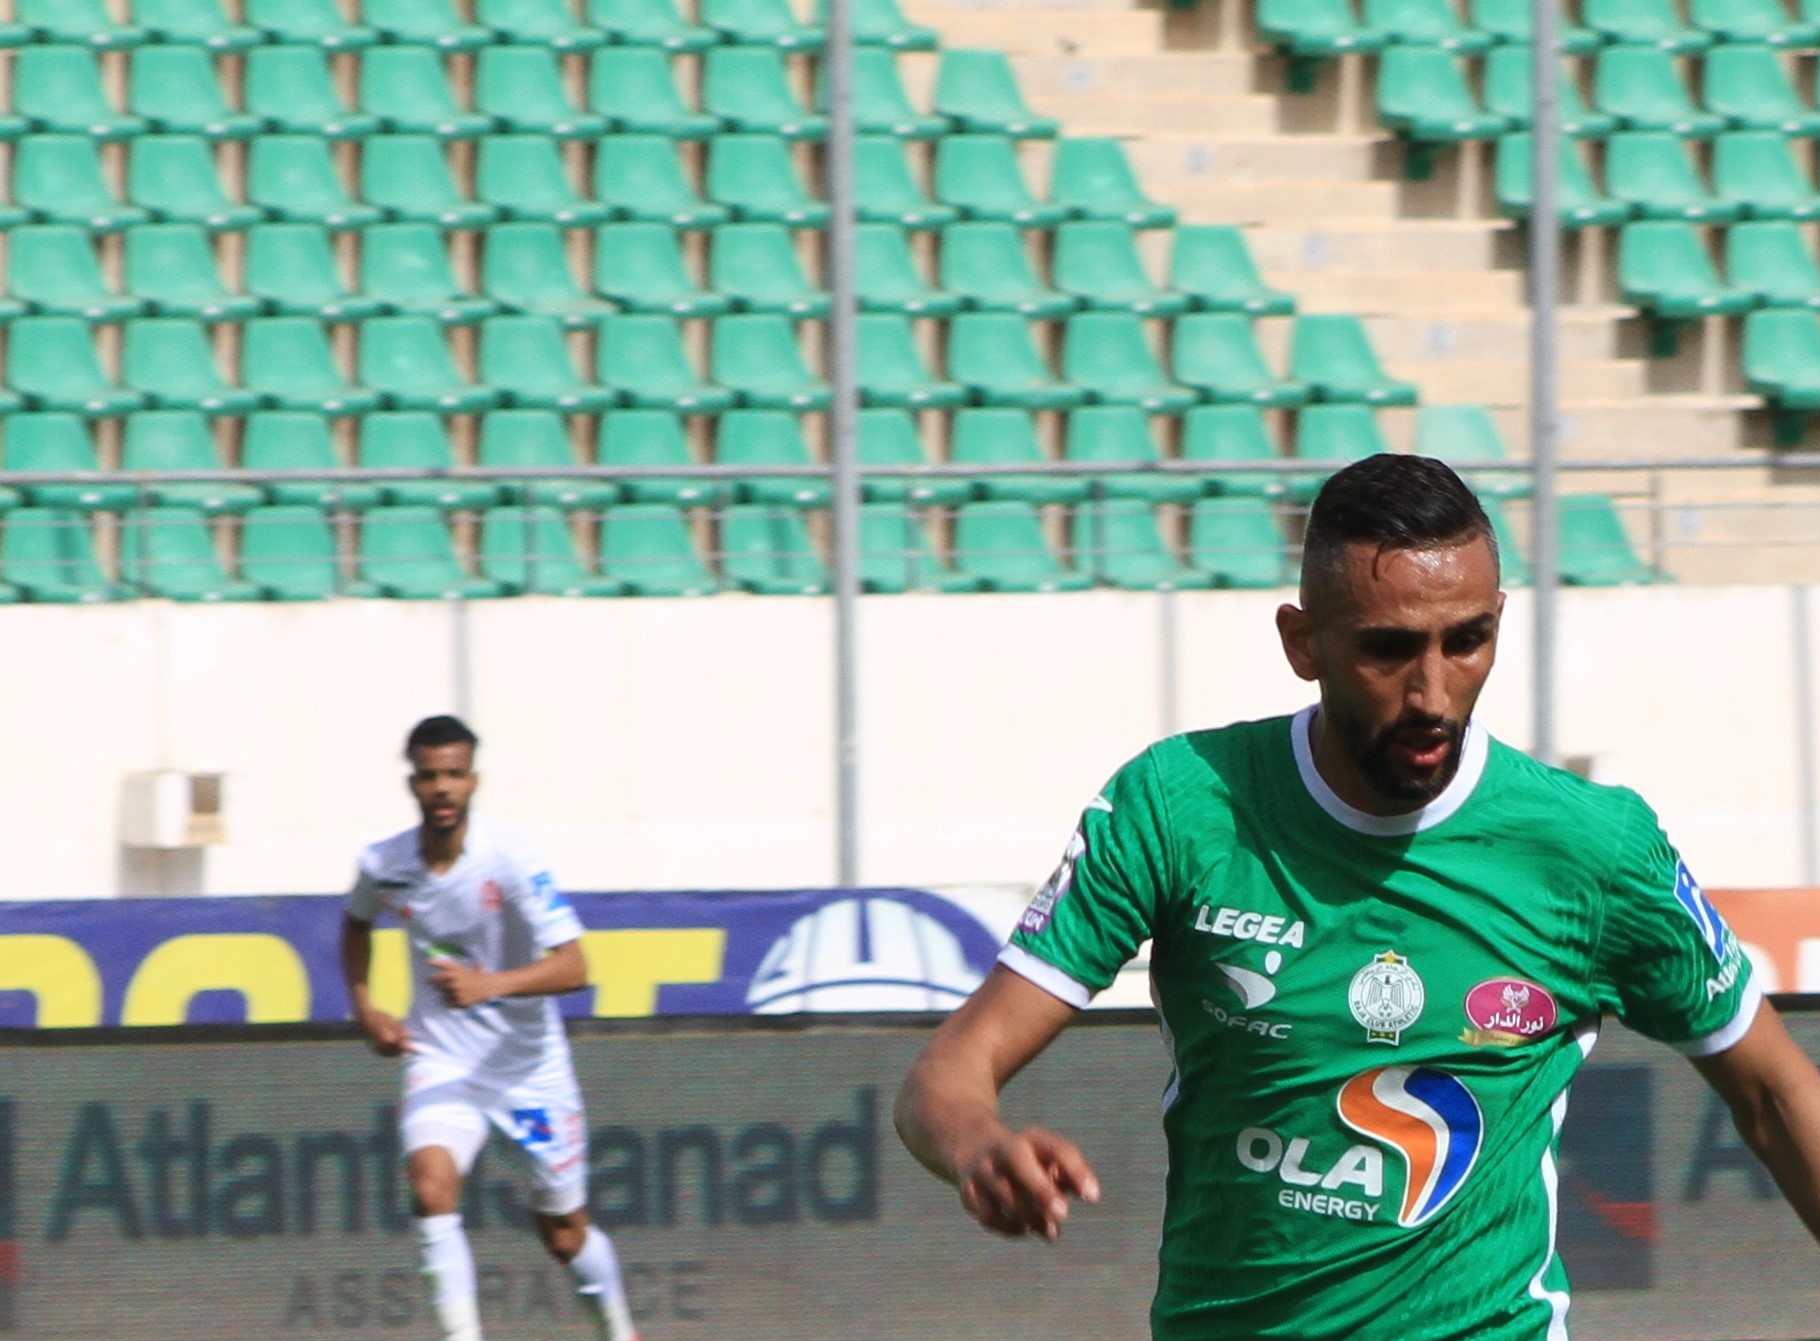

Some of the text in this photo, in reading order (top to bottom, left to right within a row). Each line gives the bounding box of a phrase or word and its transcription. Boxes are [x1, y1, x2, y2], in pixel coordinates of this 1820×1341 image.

[1195, 904, 1305, 949] LEGEA
[1202, 999, 1293, 1039] SOFAC
[1484, 1011, 1544, 1034] نور الدار
[43, 1083, 881, 1242] Atlantanad
[1236, 1127, 1383, 1197] OLA
[1278, 1189, 1380, 1221] ENERGY
[285, 1258, 703, 1330] ASSRACE
